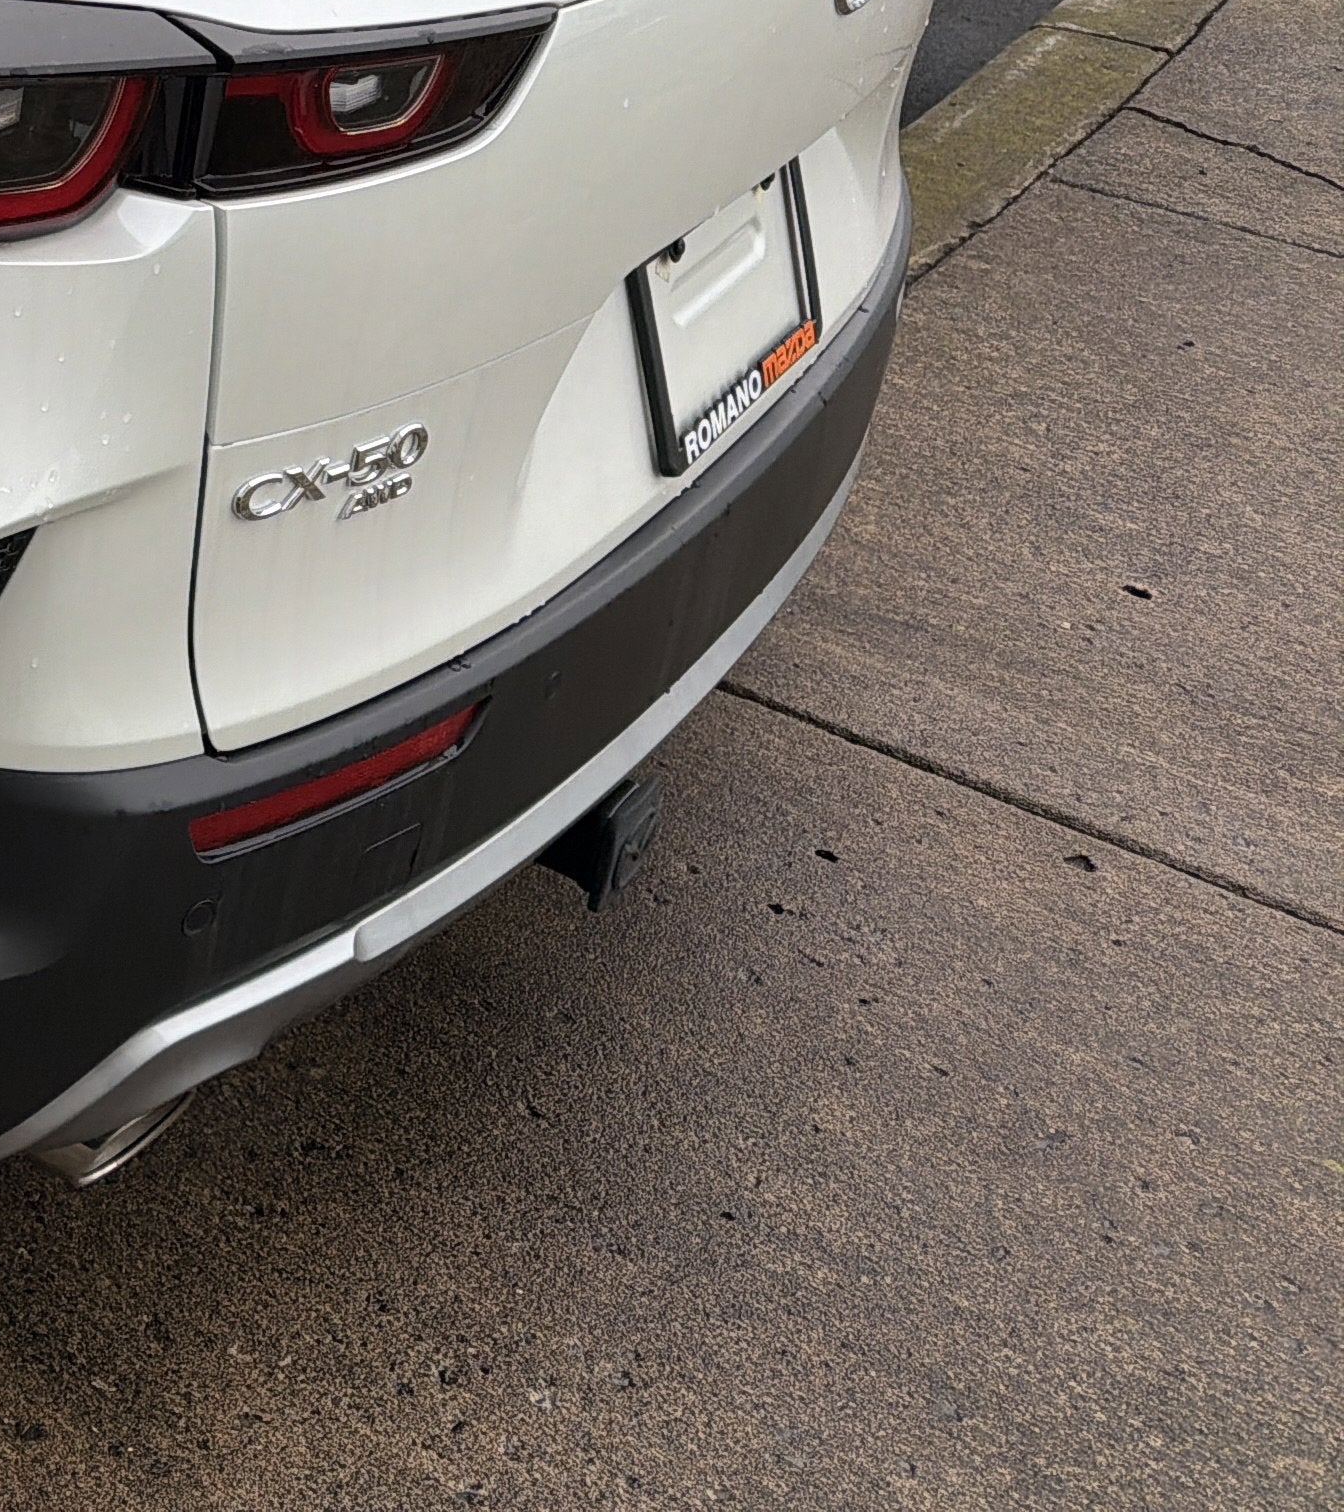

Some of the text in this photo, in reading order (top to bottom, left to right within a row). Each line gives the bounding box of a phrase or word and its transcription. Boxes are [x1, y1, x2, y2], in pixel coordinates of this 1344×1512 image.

[684, 319, 817, 465] ROMANO mazda
[231, 422, 429, 522] CX-50
[336, 471, 413, 521] AWD
